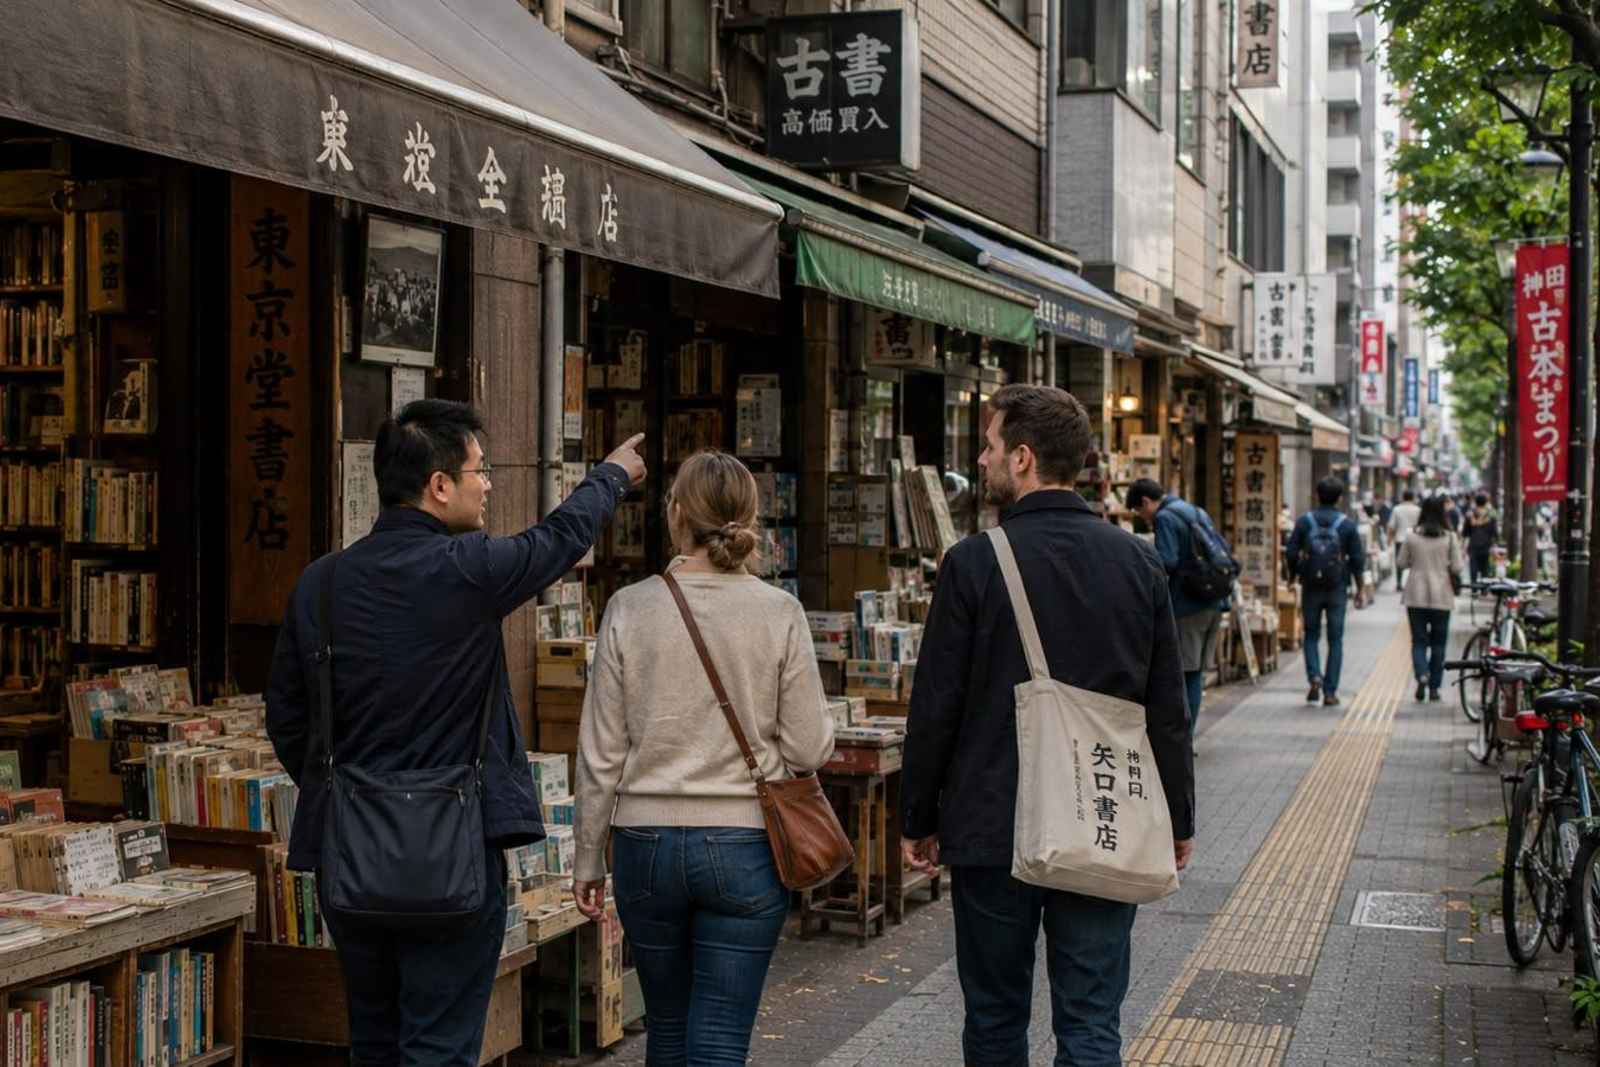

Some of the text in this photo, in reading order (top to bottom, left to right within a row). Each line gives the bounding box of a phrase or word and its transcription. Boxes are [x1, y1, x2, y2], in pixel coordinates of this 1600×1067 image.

[776, 32, 892, 100] 古書
[1243, 1, 1275, 75] 書店
[781, 105, 889, 136] 高価買入
[1522, 264, 1566, 299] 神田
[246, 207, 296, 553] 東京堂書店
[1527, 301, 1564, 484] 古本まつり
[1091, 742, 1118, 852] 矢口書店
